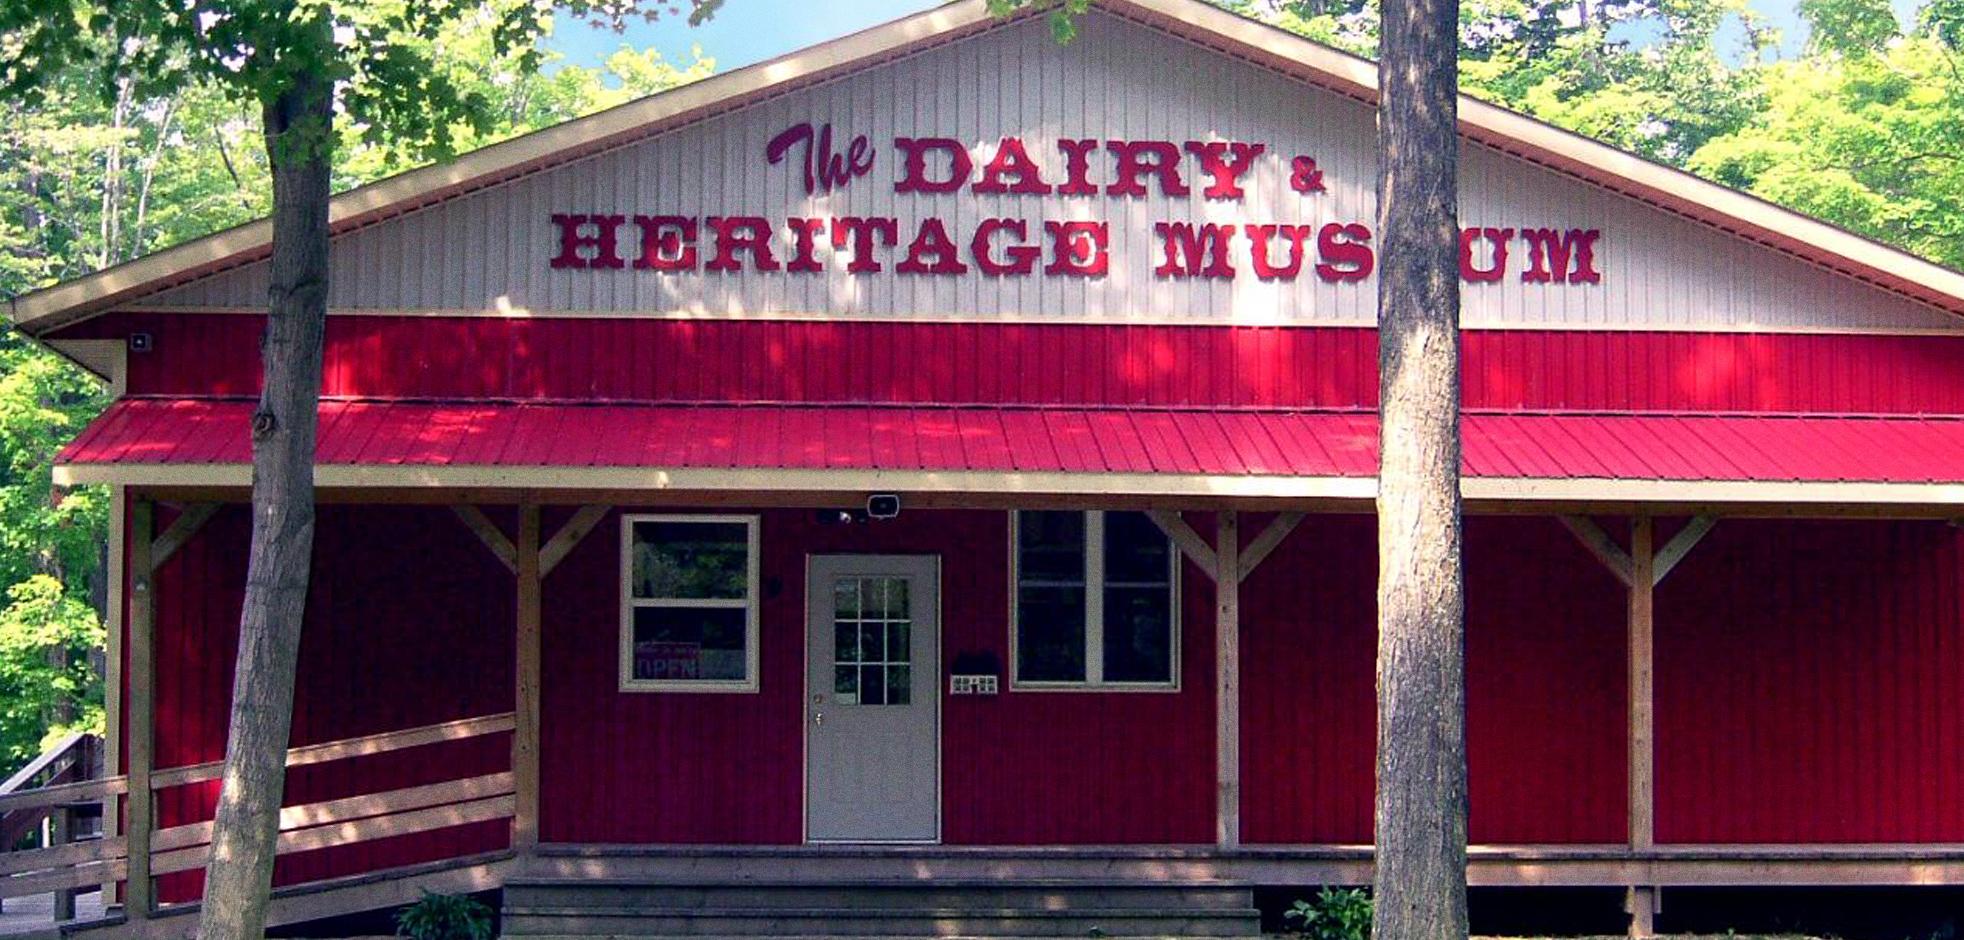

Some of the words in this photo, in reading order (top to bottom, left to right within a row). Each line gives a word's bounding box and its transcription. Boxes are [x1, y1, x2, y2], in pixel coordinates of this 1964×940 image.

[766, 122, 875, 194] The
[894, 137, 1265, 200] DAIRY
[1290, 155, 1326, 194] &
[550, 213, 1109, 278] HERITAGE
[1155, 221, 1601, 284] MUSUM
